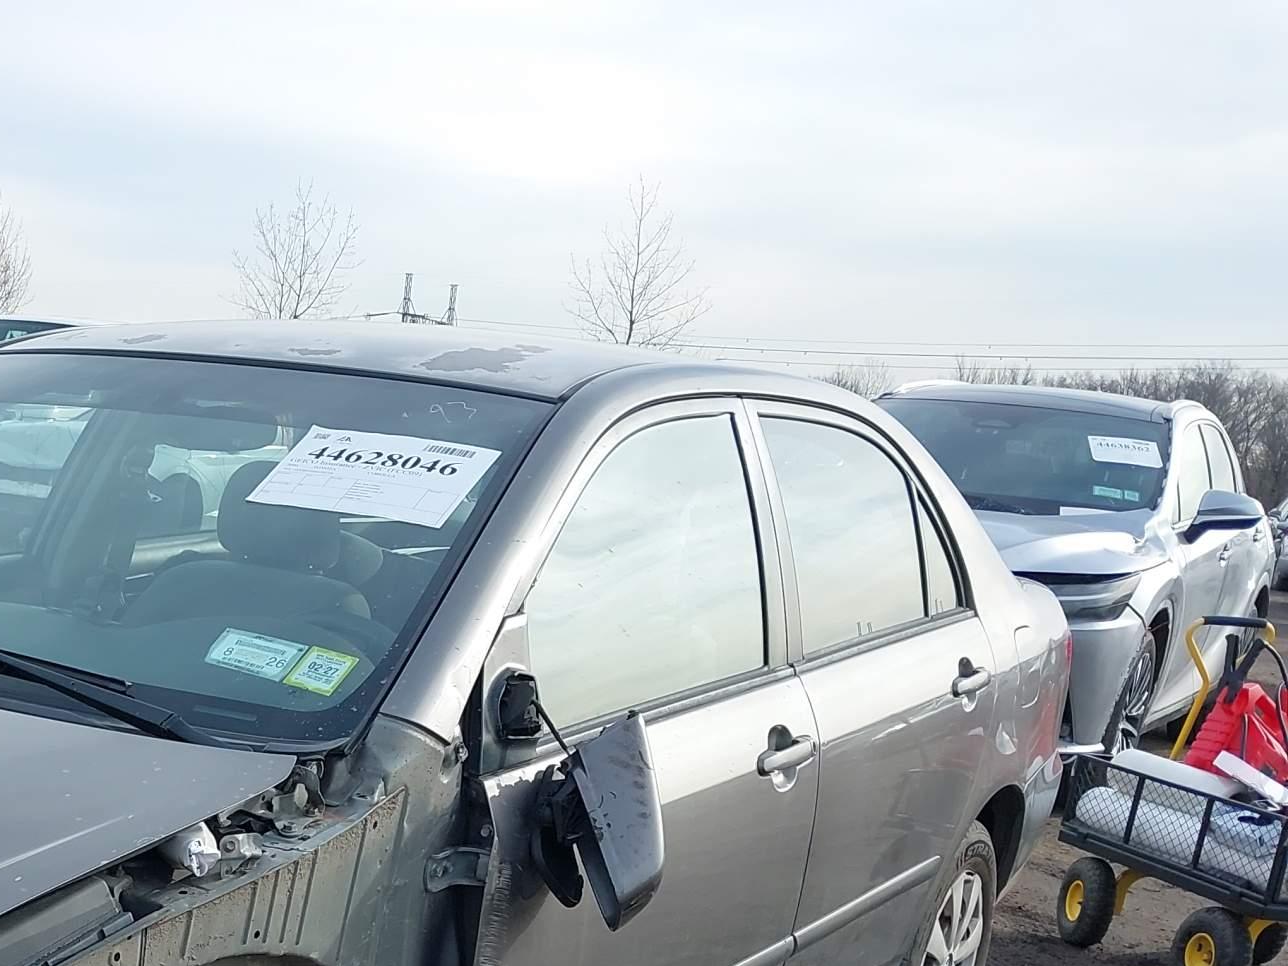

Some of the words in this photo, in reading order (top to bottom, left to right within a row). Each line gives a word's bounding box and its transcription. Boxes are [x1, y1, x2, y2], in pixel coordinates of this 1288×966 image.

[308, 446, 463, 476] 44628046
[223, 647, 234, 656] 8
[265, 656, 287, 669] 26
